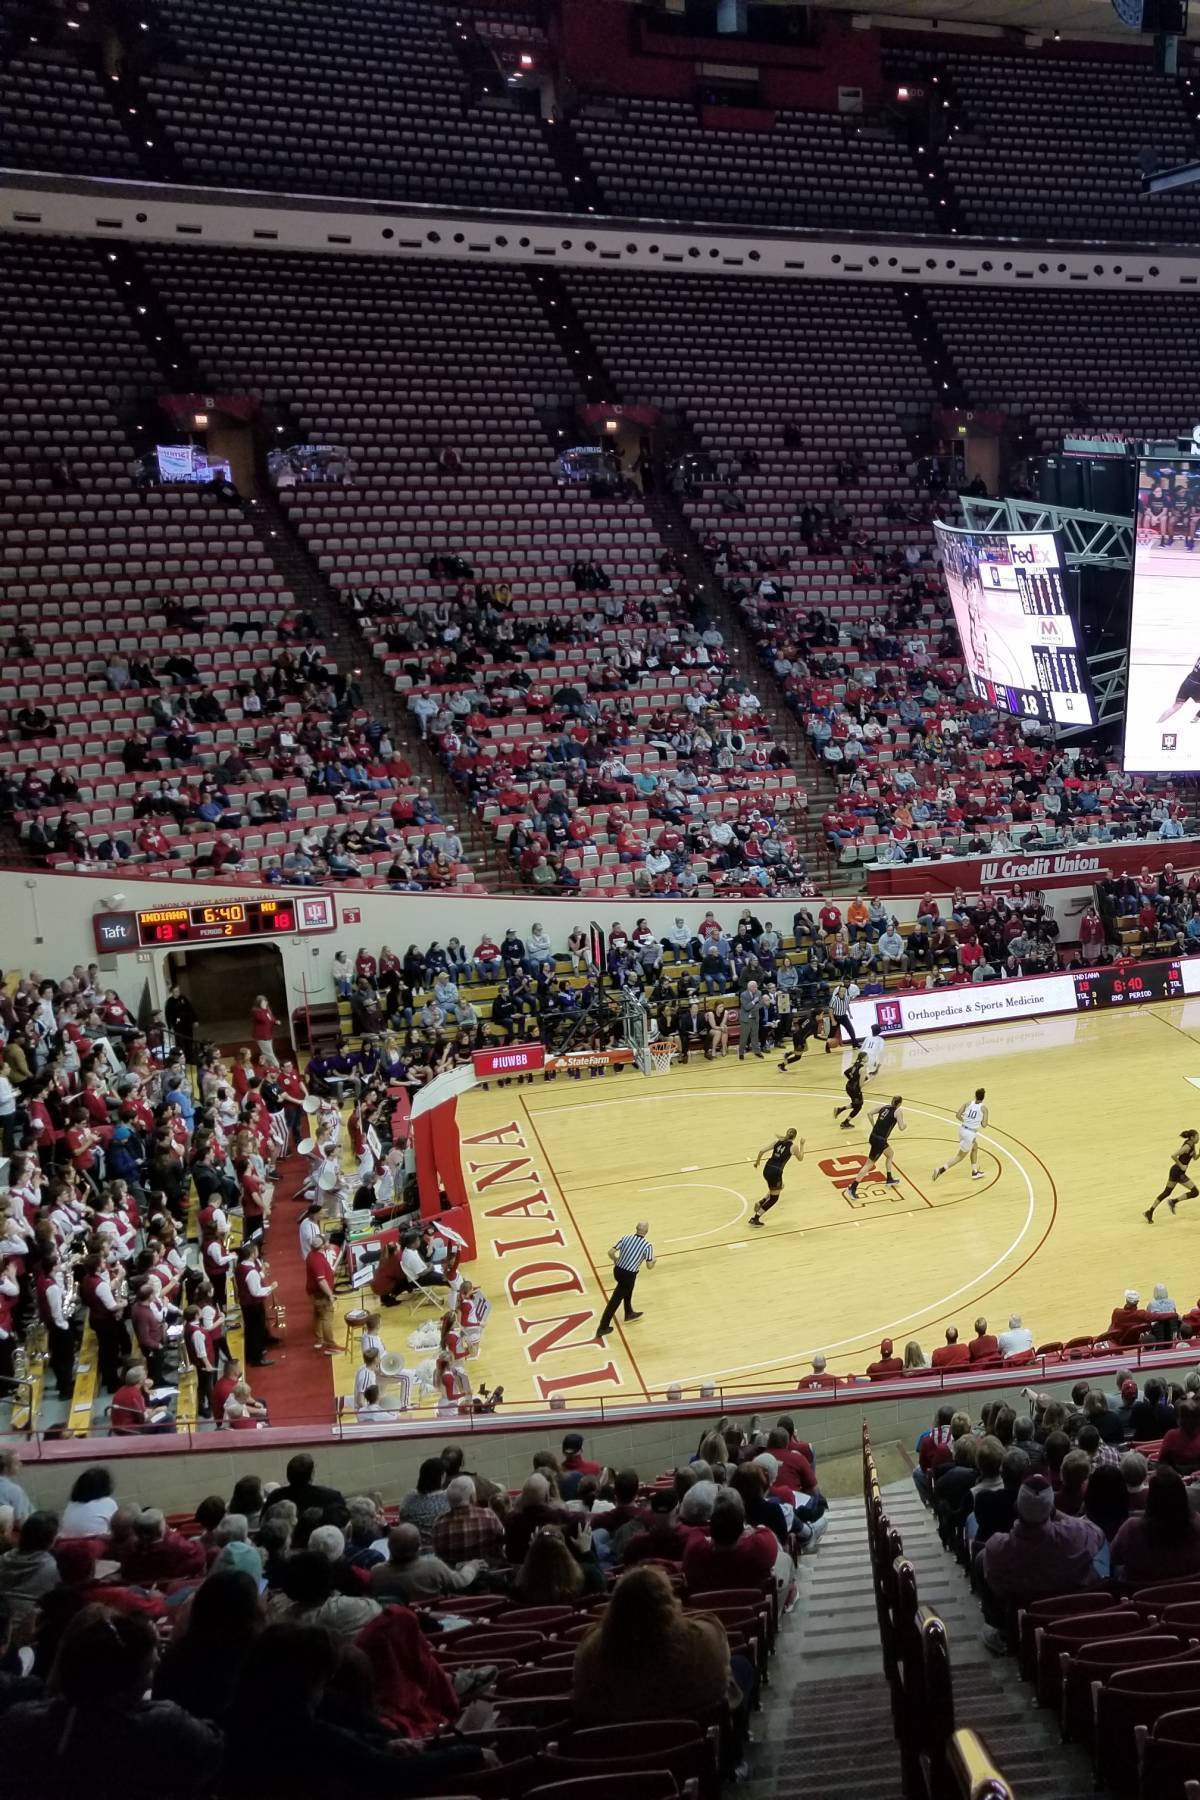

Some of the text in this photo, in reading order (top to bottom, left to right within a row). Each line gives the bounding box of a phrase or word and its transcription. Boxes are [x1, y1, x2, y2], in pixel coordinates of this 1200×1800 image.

[206, 398, 214, 408] B
[1010, 544, 1051, 563] FedEx
[1021, 694, 1039, 715] 18
[981, 854, 1099, 880] IU Credit Union
[140, 910, 187, 923] INDIANA
[204, 906, 241, 923] 6:40
[274, 914, 289, 927] 18
[348, 913, 354, 922] 3
[101, 926, 126, 938] Taft
[156, 924, 173, 939] 13
[224, 925, 232, 934] 2
[1073, 972, 1099, 980] INDIANA
[1168, 970, 1178, 979] 18
[1114, 977, 1142, 992] 6:40
[880, 1006, 896, 1024] IU
[907, 995, 1044, 1021] Orthopedics & Sports Medicine
[492, 1054, 528, 1068] #IUWBB
[967, 1110, 977, 1119] 10
[461, 1120, 621, 1400] INDIANA
